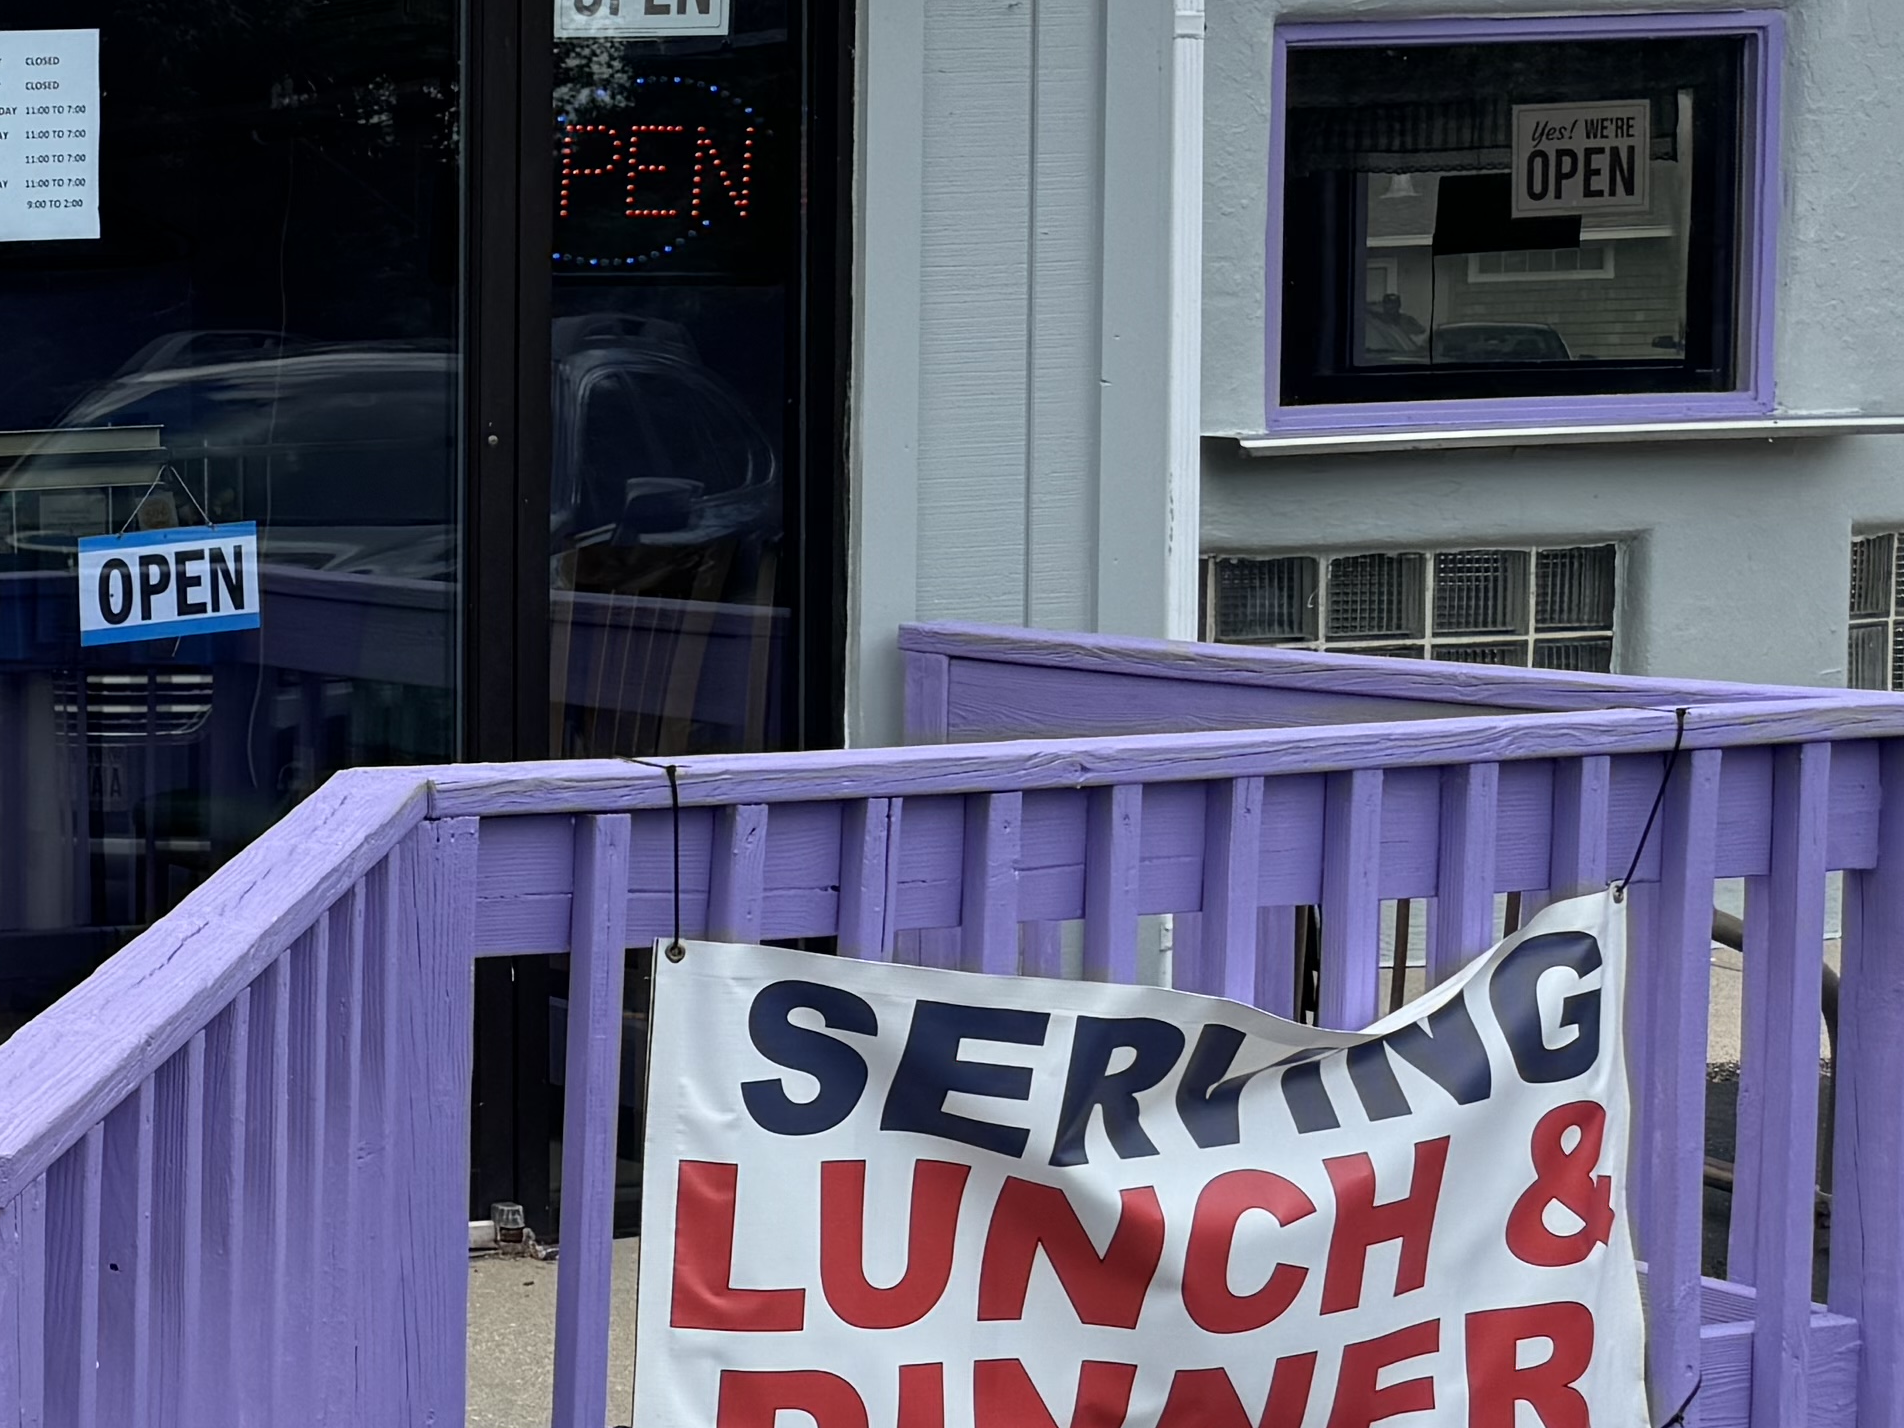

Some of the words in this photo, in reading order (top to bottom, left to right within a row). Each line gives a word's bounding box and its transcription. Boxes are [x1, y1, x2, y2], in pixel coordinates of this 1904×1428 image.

[25, 57, 59, 66] CLOSED
[25, 81, 59, 90] CLOSED
[25, 106, 49, 115] 11:00
[52, 105, 64, 114] TO
[67, 105, 86, 114] 7:00
[25, 130, 49, 139] 11:00
[52, 130, 64, 139] TO
[67, 129, 86, 138] 7:00
[1531, 118, 1579, 148] Yes!
[1584, 116, 1636, 140] WE'RE
[25, 155, 49, 164] 11:00
[52, 154, 64, 163] TO
[67, 154, 86, 163] 7:00
[560, 124, 755, 218] PEN
[1525, 145, 1636, 202] OPEN
[25, 179, 49, 188] 11:00
[52, 178, 64, 187] TO
[67, 178, 86, 187] 7:00
[27, 200, 46, 209] 9:00
[49, 199, 61, 208] TO
[64, 199, 83, 208] 2:00
[98, 544, 245, 625] OPEN
[669, 1135, 1449, 1336] LUNCH
[1505, 1099, 1614, 1269] &
